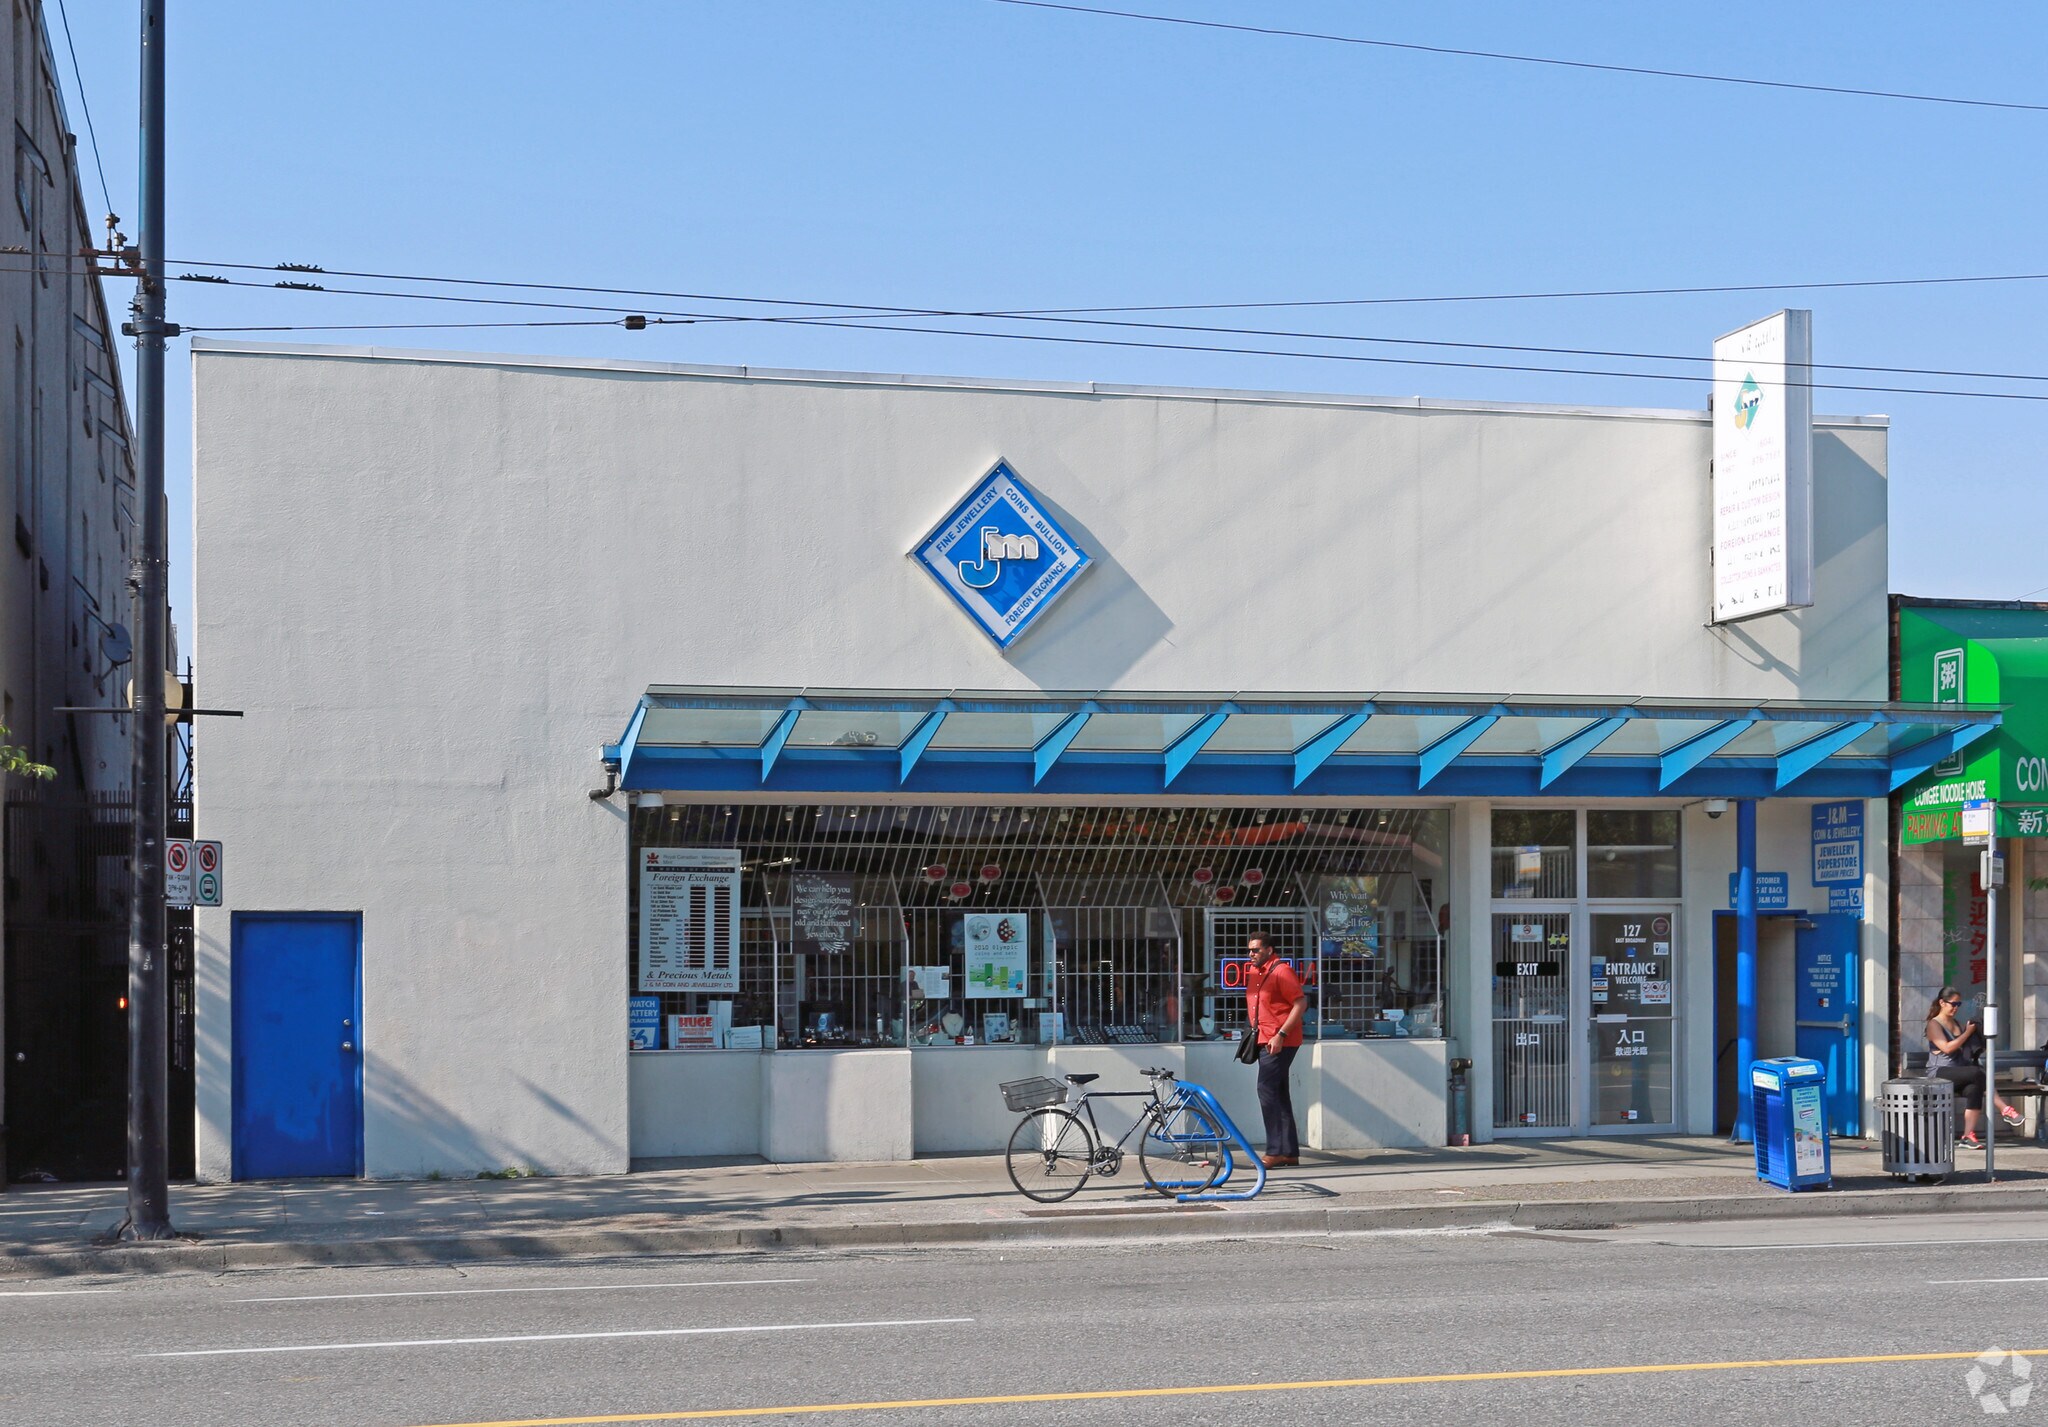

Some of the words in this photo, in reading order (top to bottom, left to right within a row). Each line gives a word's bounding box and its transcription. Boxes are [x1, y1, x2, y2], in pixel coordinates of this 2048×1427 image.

[935, 531, 956, 552] FINE
[956, 486, 998, 534] JEWELLERY
[1005, 487, 1029, 514] COINS
[1034, 521, 1067, 556] BULLION
[1747, 527, 1781, 544] EXCHANGE
[1005, 597, 1034, 627] FOREIGN
[1032, 560, 1067, 597] EXCHANGE
[1915, 785, 1939, 806] CONGEE
[1940, 783, 1964, 804] NOODLE
[1966, 780, 1985, 800] HOUSE
[1827, 806, 1847, 824] J&M
[2018, 809, 2048, 834] 新
[1907, 812, 1948, 840] PARKING
[1814, 829, 1826, 840] COIN
[1820, 844, 1855, 857] JEWELLERY
[1817, 856, 1857, 870] SUPERSTORE
[653, 873, 686, 883] Foreign
[688, 874, 729, 883] Exchange
[1820, 870, 1839, 879] BARGAIN
[1839, 869, 1855, 877] PRICES
[1330, 890, 1349, 901] Why
[1349, 904, 1368, 914] sale?
[1624, 925, 1641, 937] 127
[1516, 963, 1539, 976] EXIT
[1606, 963, 1656, 976] ENTRANCE
[1616, 976, 1647, 984] WELCOME
[678, 1017, 713, 1027] HUGE
[1516, 1033, 1540, 1046] 出口
[1617, 1030, 1645, 1045] 入口
